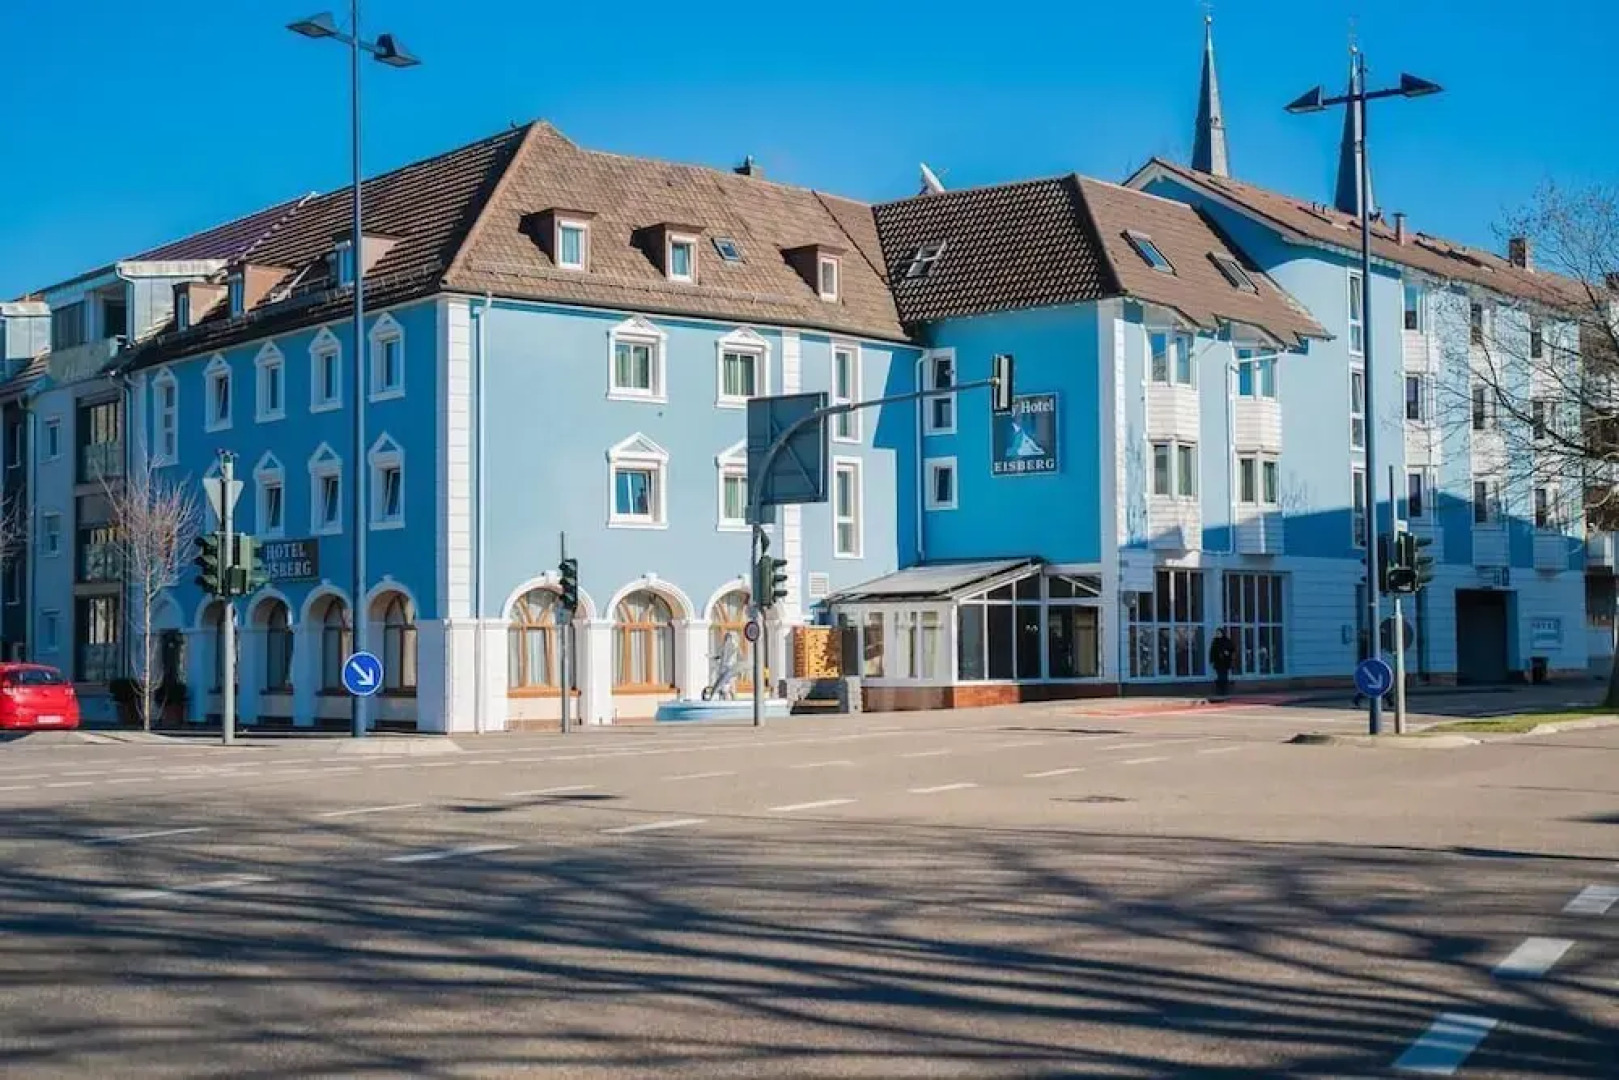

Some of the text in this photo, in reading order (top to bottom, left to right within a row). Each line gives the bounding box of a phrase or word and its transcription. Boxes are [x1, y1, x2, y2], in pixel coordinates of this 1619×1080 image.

[1021, 398, 1054, 413] Hotel
[994, 458, 1055, 472] EISBERG
[266, 543, 306, 559] HOTEL
[267, 561, 312, 578] ISBERG
